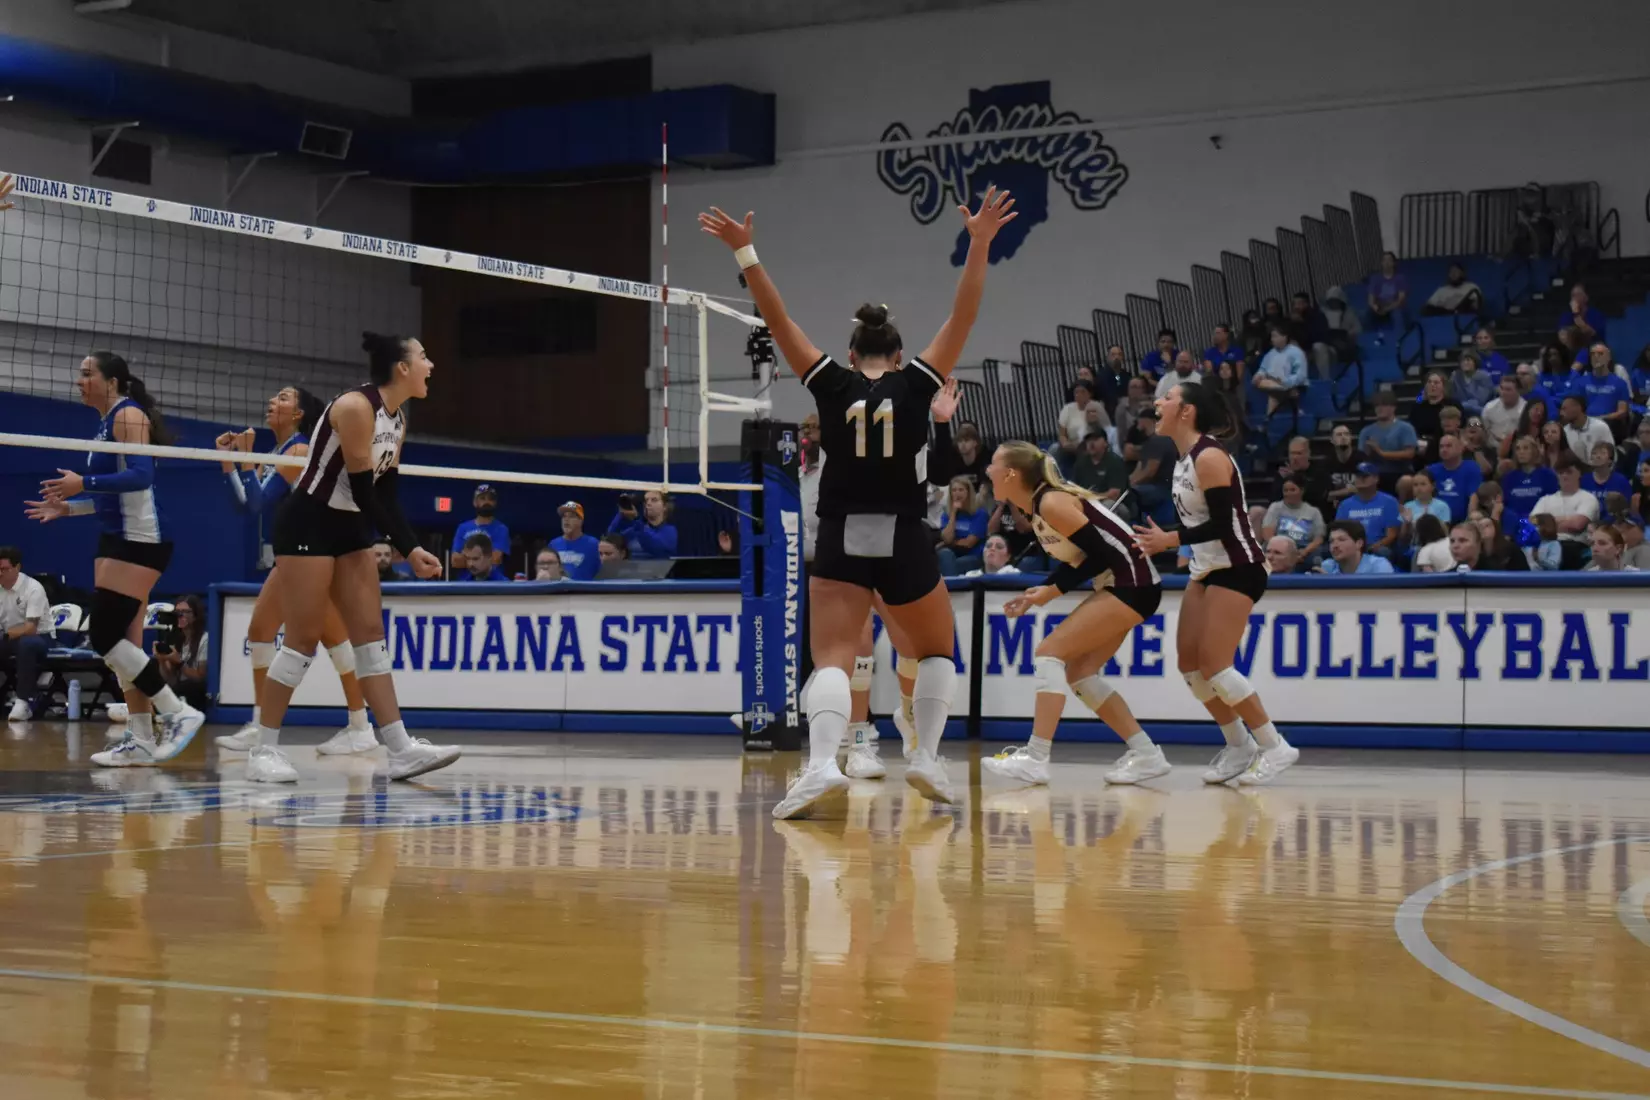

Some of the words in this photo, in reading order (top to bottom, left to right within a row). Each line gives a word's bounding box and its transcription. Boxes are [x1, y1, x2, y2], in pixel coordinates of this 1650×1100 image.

[15, 175, 68, 200] INDIANA
[72, 186, 113, 208] STATE
[189, 206, 236, 229] INDIANA
[239, 215, 275, 235] STATE
[342, 233, 383, 254] INDIANA
[386, 241, 418, 260] STATE
[477, 256, 514, 276] INDIANA
[517, 263, 545, 280] STATE
[597, 276, 630, 296] INDIANA
[632, 281, 658, 298] STATE
[845, 398, 894, 458] 11
[598, 614, 742, 672] STAT
[754, 615, 764, 651] sports
[754, 652, 764, 696] imports
[784, 643, 799, 727] STATE
